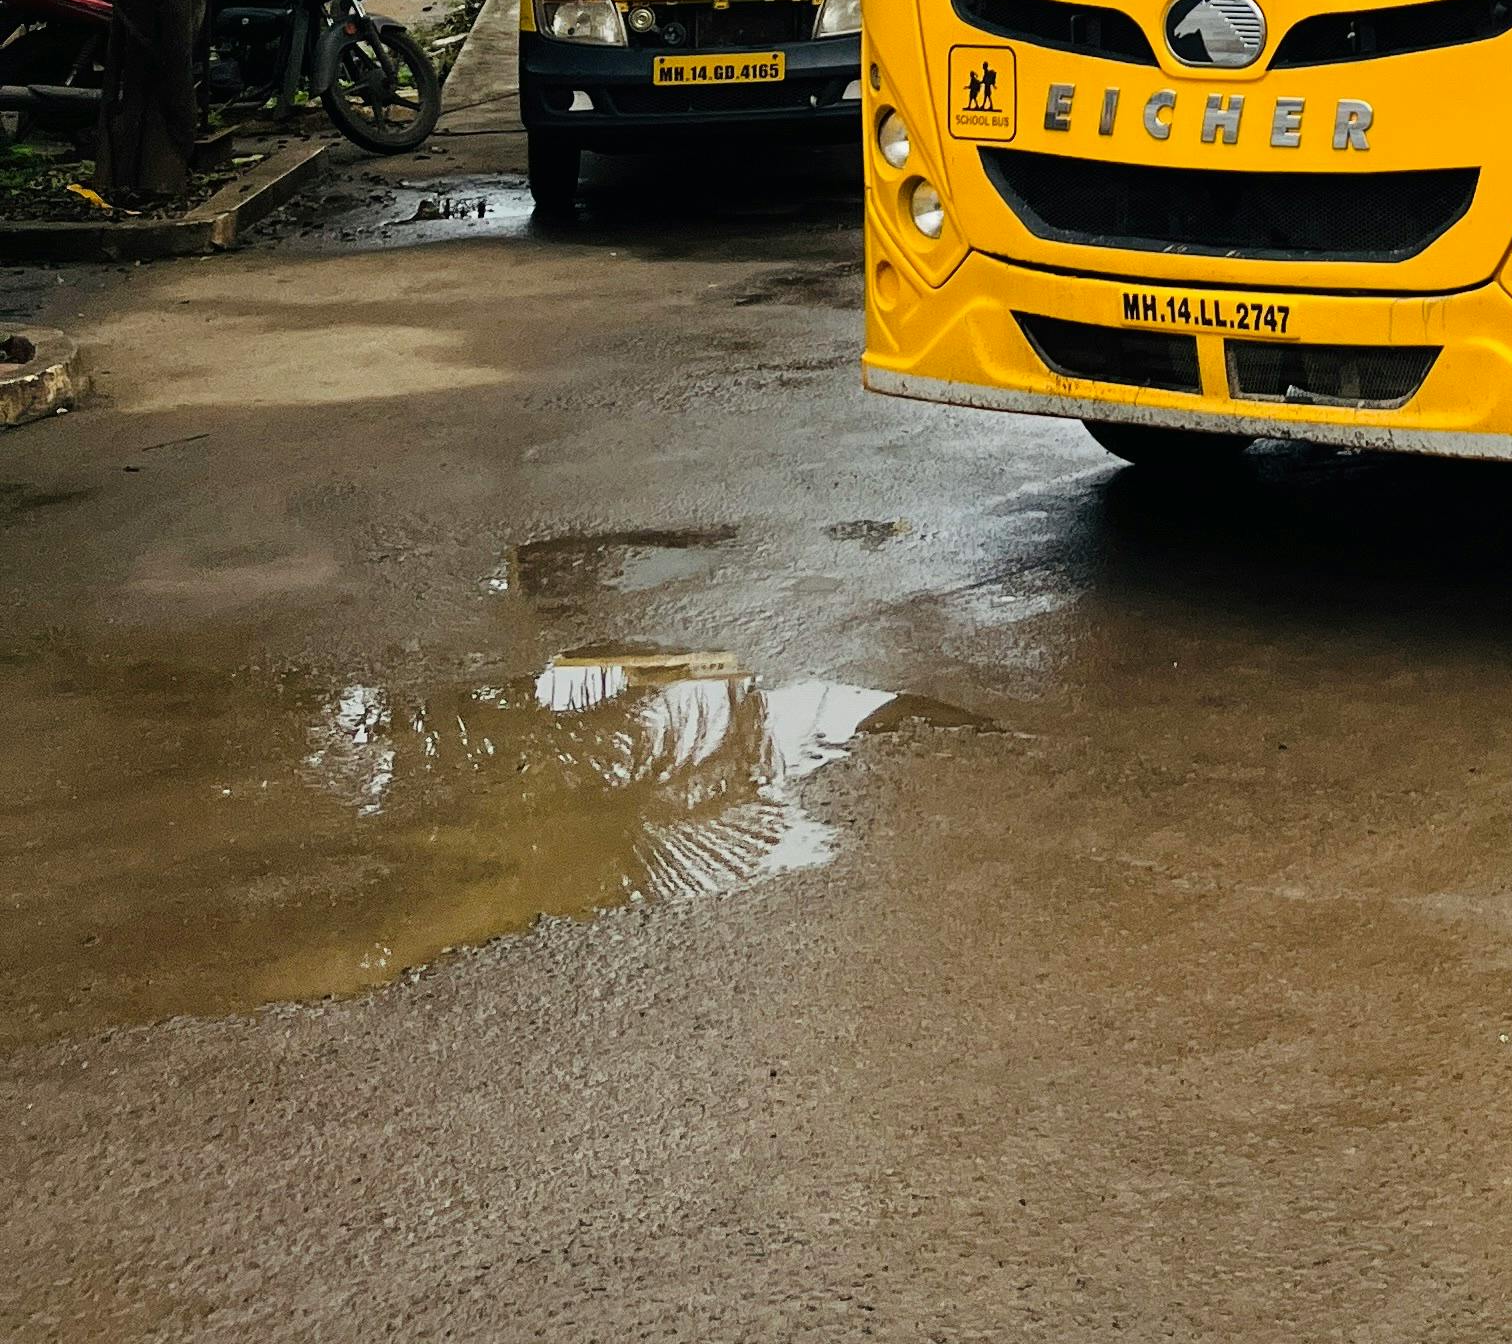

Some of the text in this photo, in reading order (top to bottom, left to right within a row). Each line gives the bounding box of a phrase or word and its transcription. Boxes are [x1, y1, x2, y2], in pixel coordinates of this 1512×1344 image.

[659, 63, 779, 83] MH.14.GD.4165
[956, 114, 1009, 127] SCHOOL BUS
[1043, 83, 1374, 151] EICHER
[1122, 292, 1290, 334] MH.14.LL.2747
